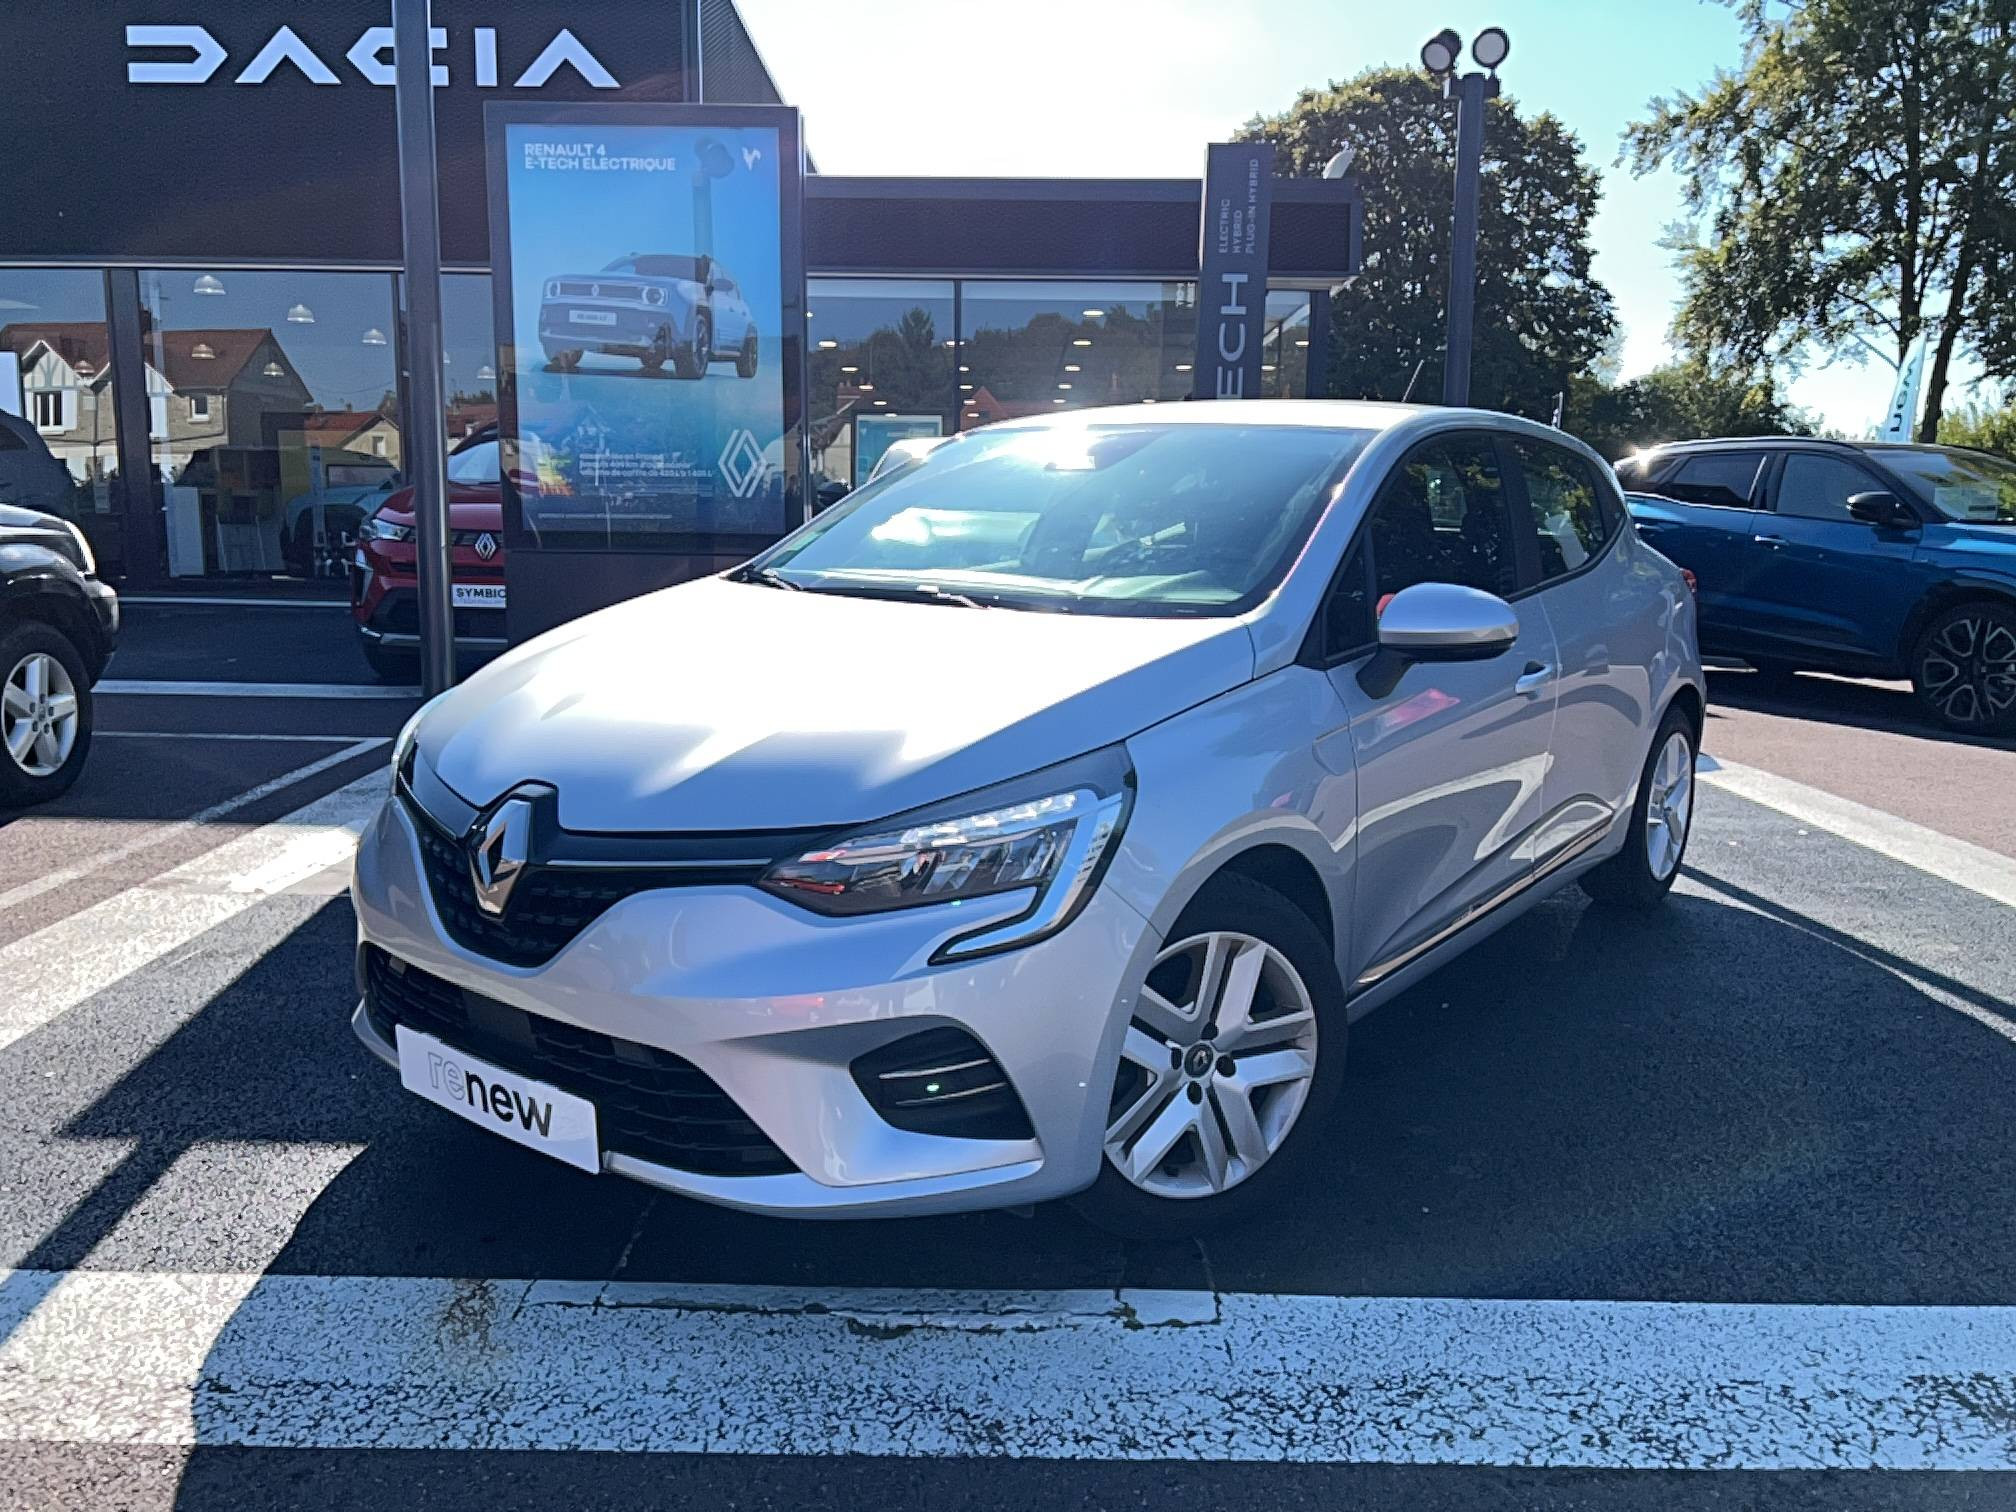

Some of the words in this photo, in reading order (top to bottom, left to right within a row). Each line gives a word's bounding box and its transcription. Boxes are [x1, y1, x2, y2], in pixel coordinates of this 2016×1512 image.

[125, 24, 622, 88] DACIA
[524, 143, 594, 156] RENAULT
[596, 143, 606, 156] 4
[524, 157, 580, 170] E-TECH
[1248, 158, 1259, 203] HYBRID
[1219, 198, 1231, 254] ELECTRIC
[1232, 209, 1243, 254] HYBRID
[1245, 205, 1257, 255] PLUG-IN
[428, 1052, 552, 1138] renew
